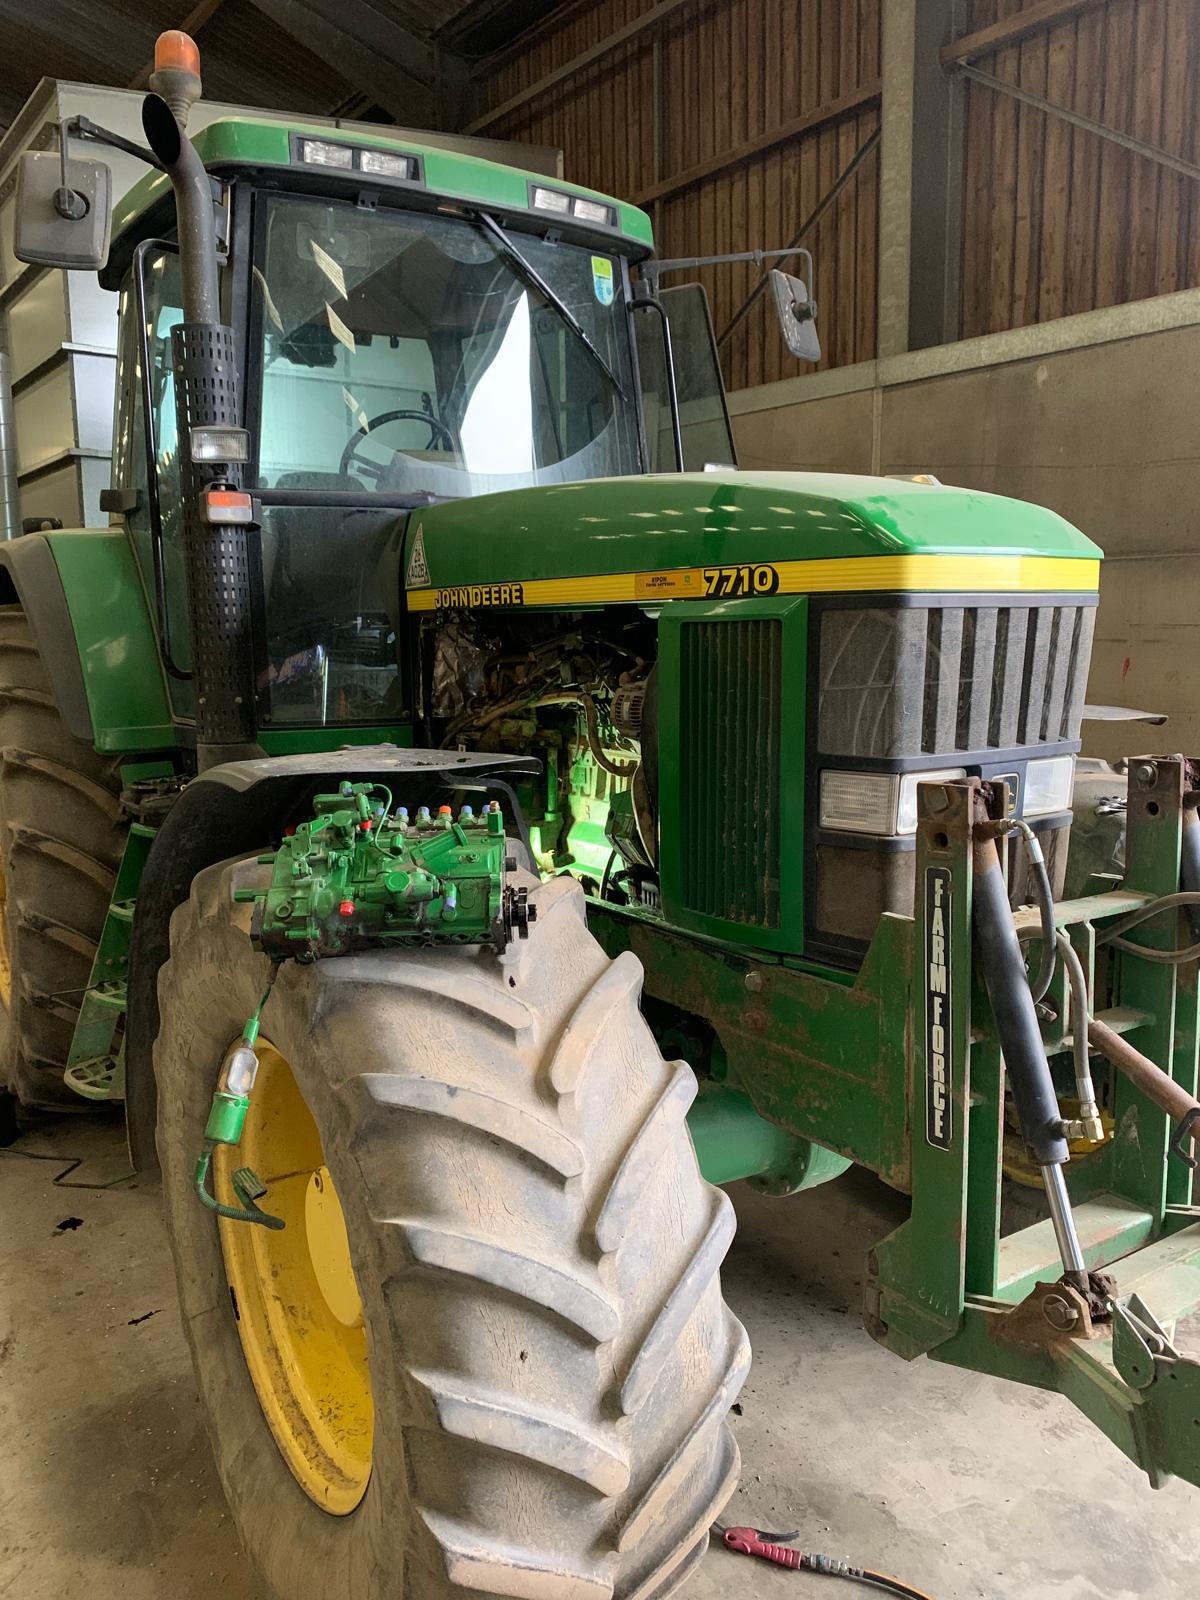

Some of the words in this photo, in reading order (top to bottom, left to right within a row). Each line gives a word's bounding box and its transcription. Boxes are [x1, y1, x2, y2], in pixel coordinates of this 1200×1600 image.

[434, 588, 469, 609] JOHN
[471, 584, 524, 607] DEERE
[704, 565, 779, 597] 7710
[930, 878, 947, 994] FARM
[932, 996, 946, 1139] FORCE
